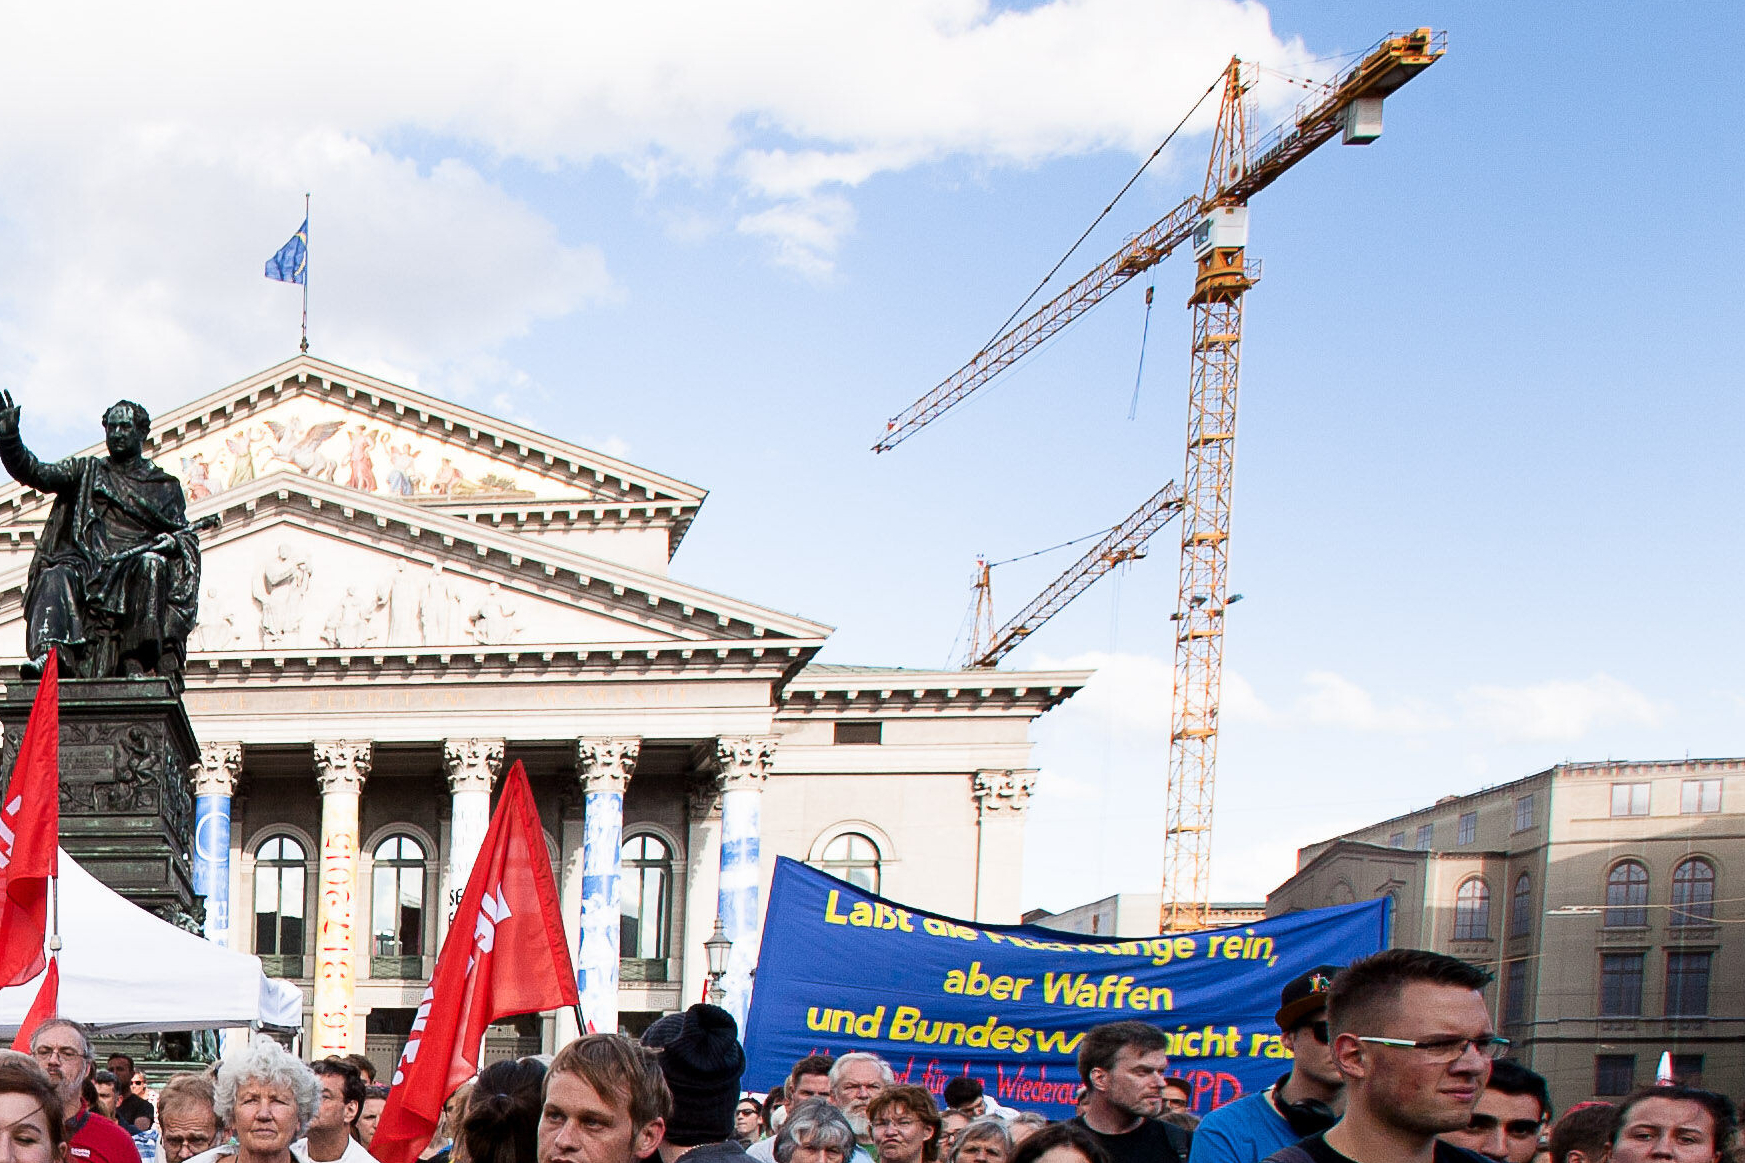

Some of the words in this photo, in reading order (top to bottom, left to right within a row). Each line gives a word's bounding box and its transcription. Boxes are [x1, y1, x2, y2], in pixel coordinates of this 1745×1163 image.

[1207, 928, 1280, 968] rein,
[943, 961, 1034, 1001] aber
[1042, 971, 1175, 1012] Waffen
[806, 1005, 886, 1039] und
[888, 1005, 1089, 1055] Bundesw
[1248, 1033, 1296, 1060] ra
[996, 1060, 1086, 1106] Wiederau
